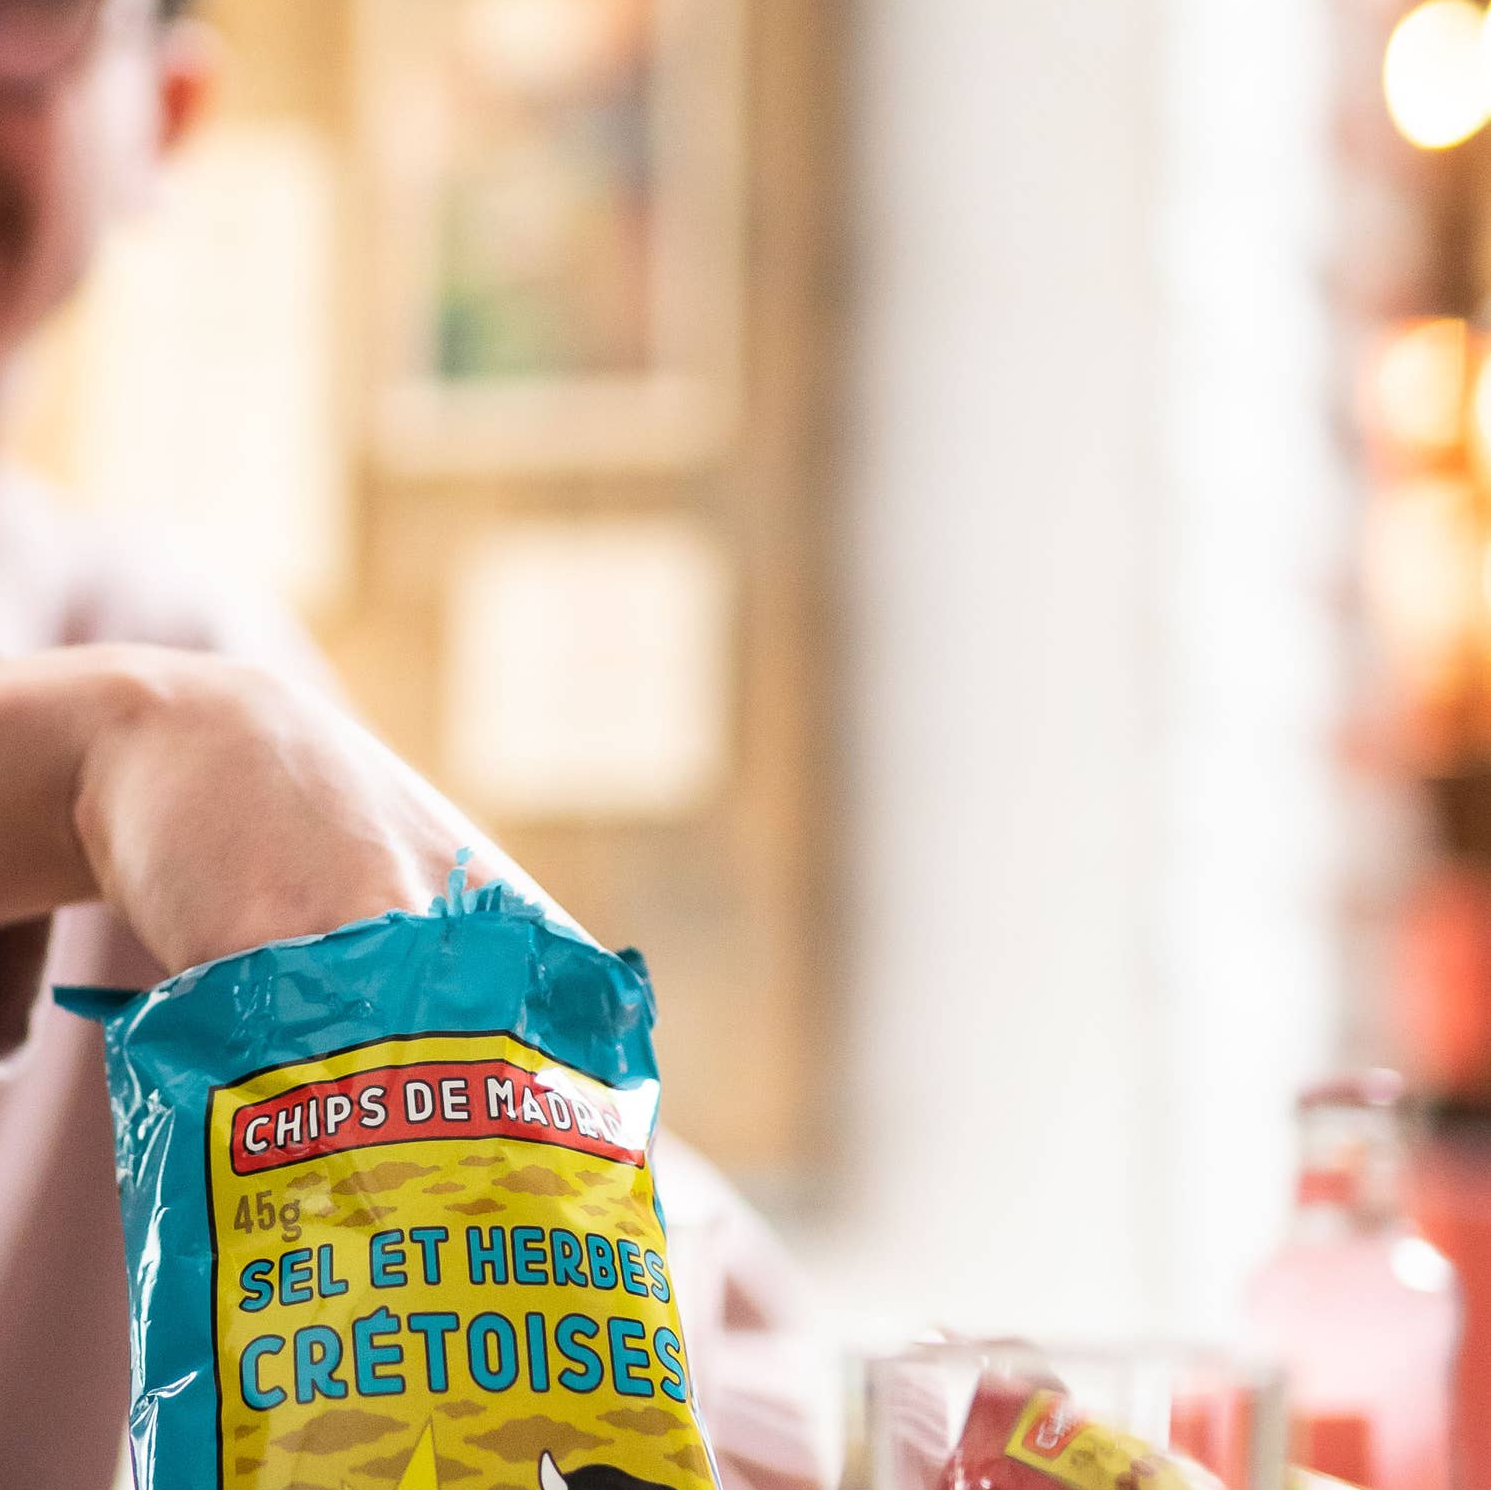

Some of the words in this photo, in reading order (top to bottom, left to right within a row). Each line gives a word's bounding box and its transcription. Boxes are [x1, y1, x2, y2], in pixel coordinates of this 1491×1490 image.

[243, 1085, 388, 1156] CHIPS
[403, 1077, 471, 1124] DE
[233, 1190, 302, 1243] 45g
[238, 1243, 349, 1313] SEL
[369, 1227, 449, 1289] ET
[466, 1225, 671, 1304] HERBES
[239, 1305, 688, 1412] CRÉTOISES
